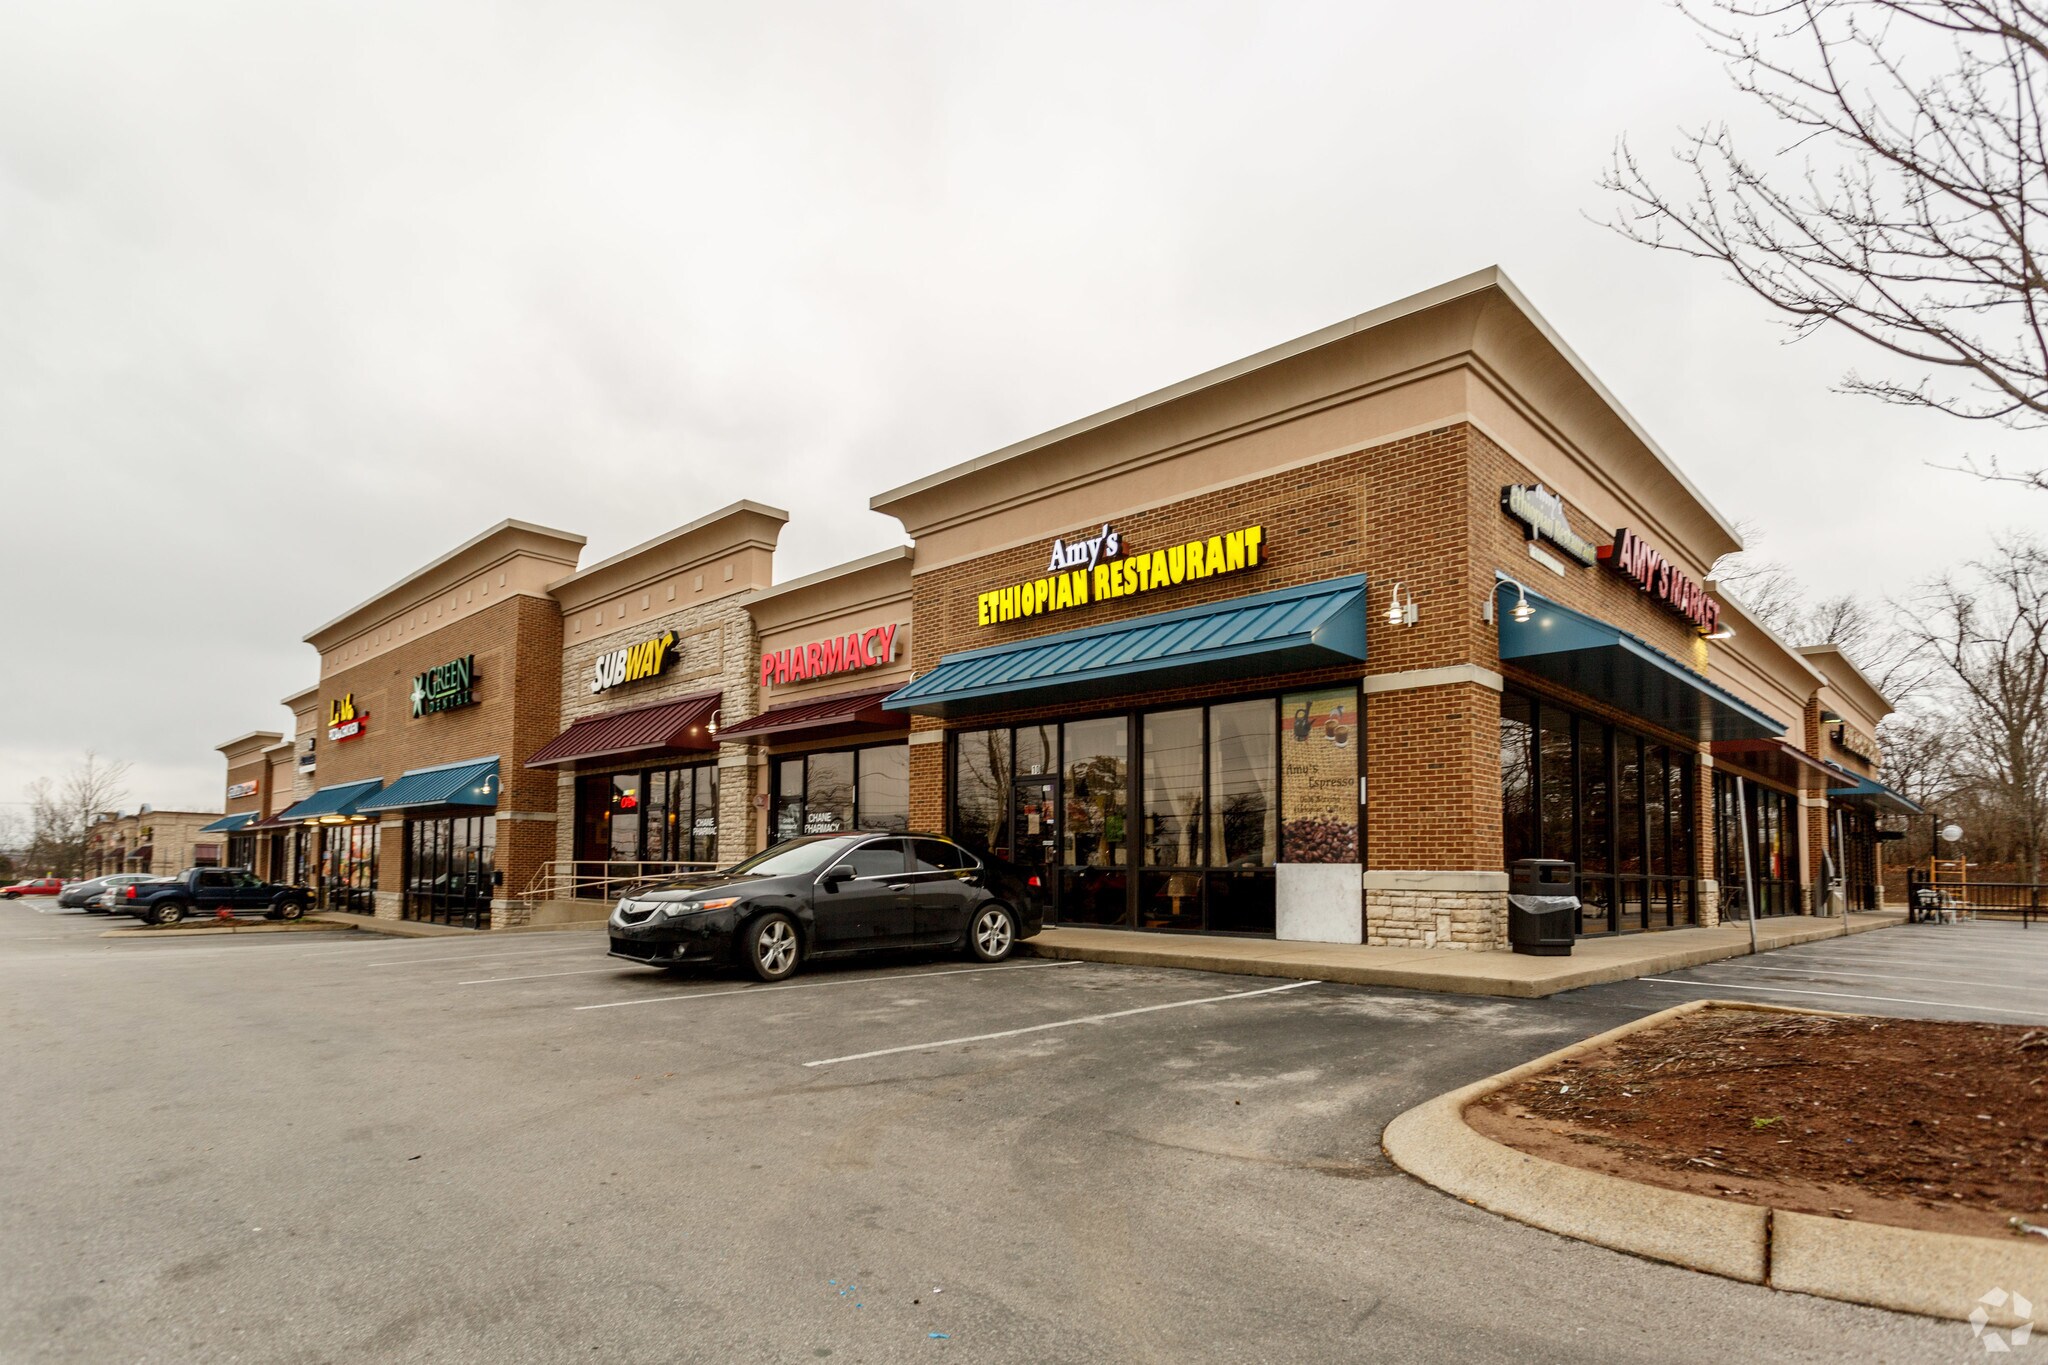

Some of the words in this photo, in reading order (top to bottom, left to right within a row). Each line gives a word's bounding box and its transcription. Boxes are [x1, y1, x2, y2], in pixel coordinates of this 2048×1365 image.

[1047, 524, 1119, 571] Amy's
[978, 569, 1089, 626] ETHIOPIAN
[1094, 525, 1262, 602] RESTAURANT
[1618, 528, 1669, 599] AMY'S
[1669, 566, 1720, 635] MARKET
[591, 632, 675, 693] SUBWAY
[761, 624, 897, 687] PHARMACY
[426, 655, 471, 700] GREEN
[428, 690, 469, 713] DENTAL
[1286, 764, 1319, 776] Amy's
[1309, 776, 1355, 790] Espresso
[692, 826, 718, 836] PHARMAC
[804, 823, 840, 834] PHARMACY
[808, 812, 832, 822] CHANE
